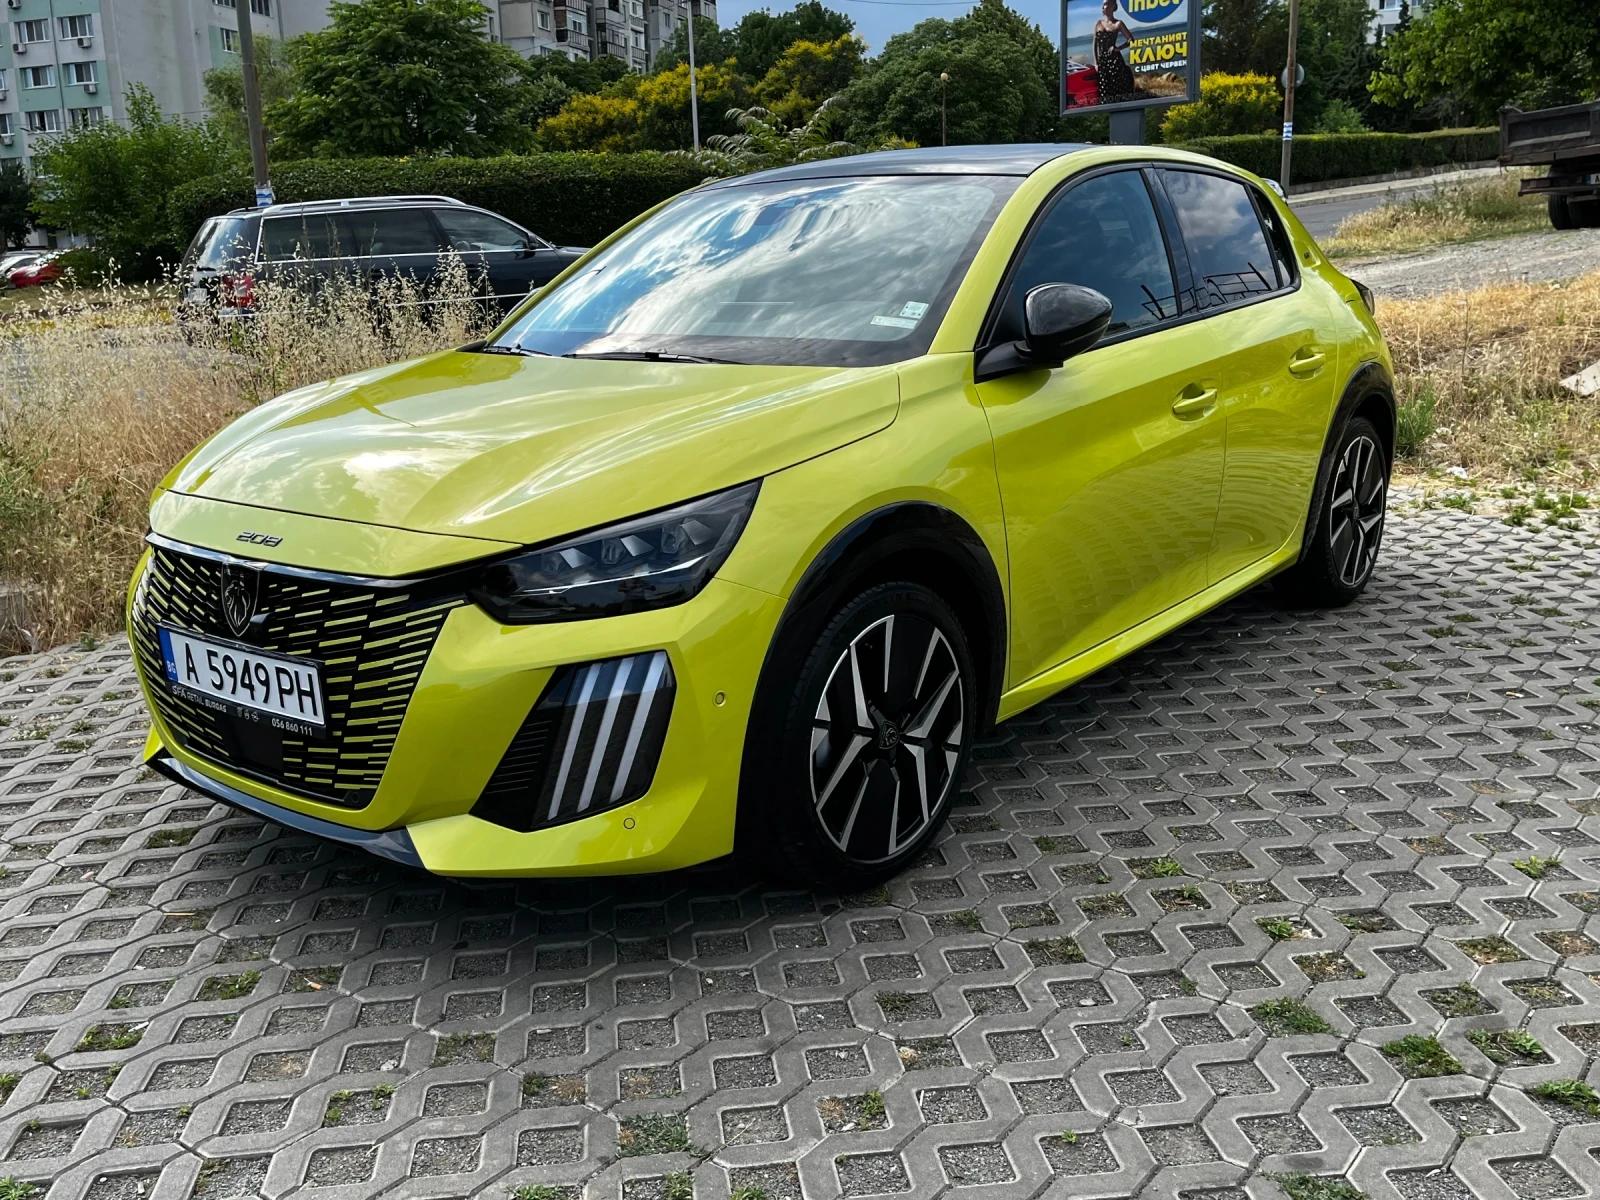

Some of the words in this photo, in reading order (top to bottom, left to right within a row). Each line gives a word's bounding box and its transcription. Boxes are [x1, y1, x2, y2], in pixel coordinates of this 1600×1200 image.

[1130, 32, 1187, 47] МЕЧТАНИЯТ
[1130, 42, 1187, 64] КЛЮЧ
[1141, 64, 1159, 72] ЦВЯТ
[1161, 60, 1187, 69] ЧЕРВЕН
[236, 531, 283, 548] 208
[166, 660, 177, 674] BG
[172, 685, 187, 699] SFA
[271, 717, 285, 729] 056
[285, 721, 299, 733] 860
[299, 725, 313, 736] 111
